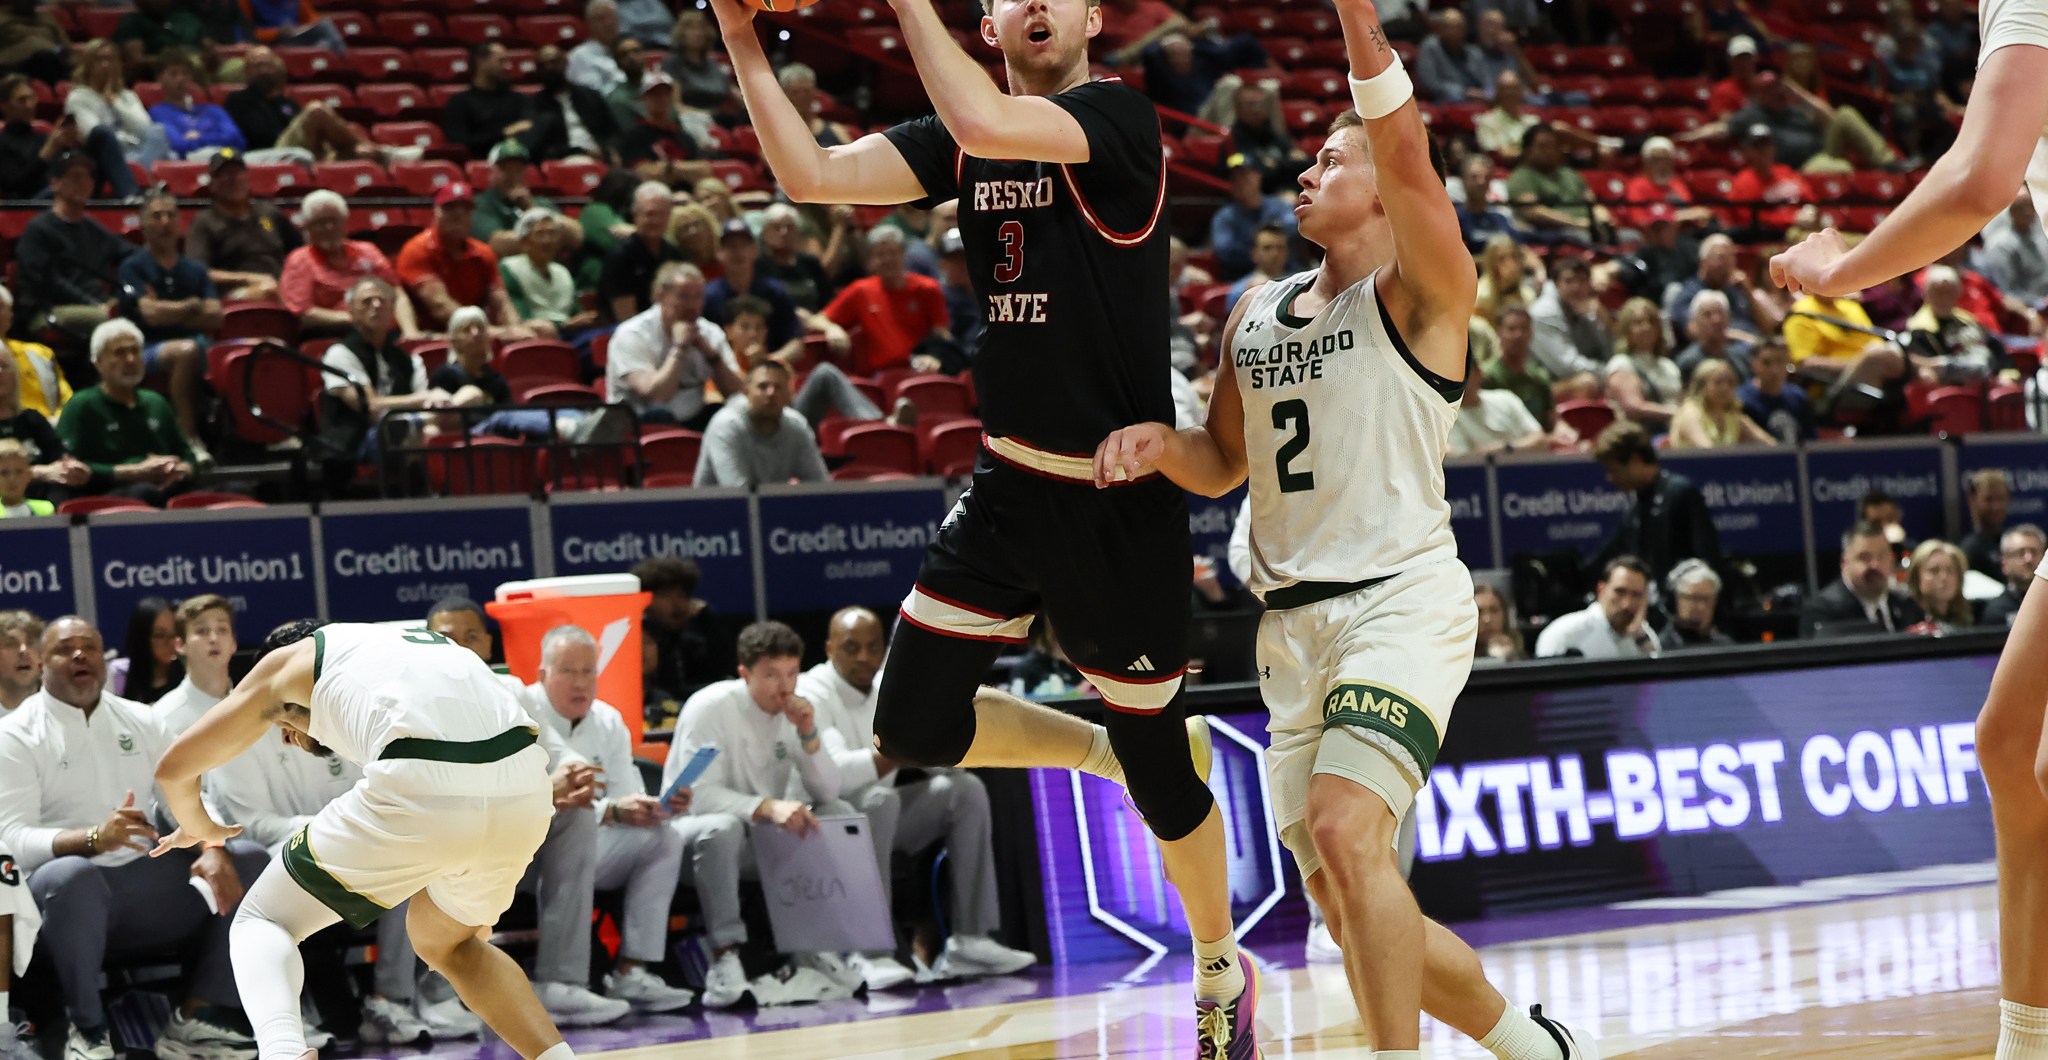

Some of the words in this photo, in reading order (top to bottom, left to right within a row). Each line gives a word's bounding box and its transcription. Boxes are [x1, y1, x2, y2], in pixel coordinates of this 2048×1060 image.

[974, 177, 1054, 211] RESNO
[994, 221, 1024, 283] 3
[1236, 330, 1354, 367] COLORADO
[1251, 359, 1323, 389] STATE
[1271, 398, 1315, 494] 2
[1503, 488, 1567, 518] Credit
[563, 532, 646, 564] Credit
[769, 523, 848, 554] Credit
[104, 555, 197, 589] Credit
[334, 543, 423, 577] Credit
[1326, 690, 1409, 728] RAMS
[1415, 739, 1785, 858] IXTH-BEST
[1800, 721, 1979, 818] CONF
